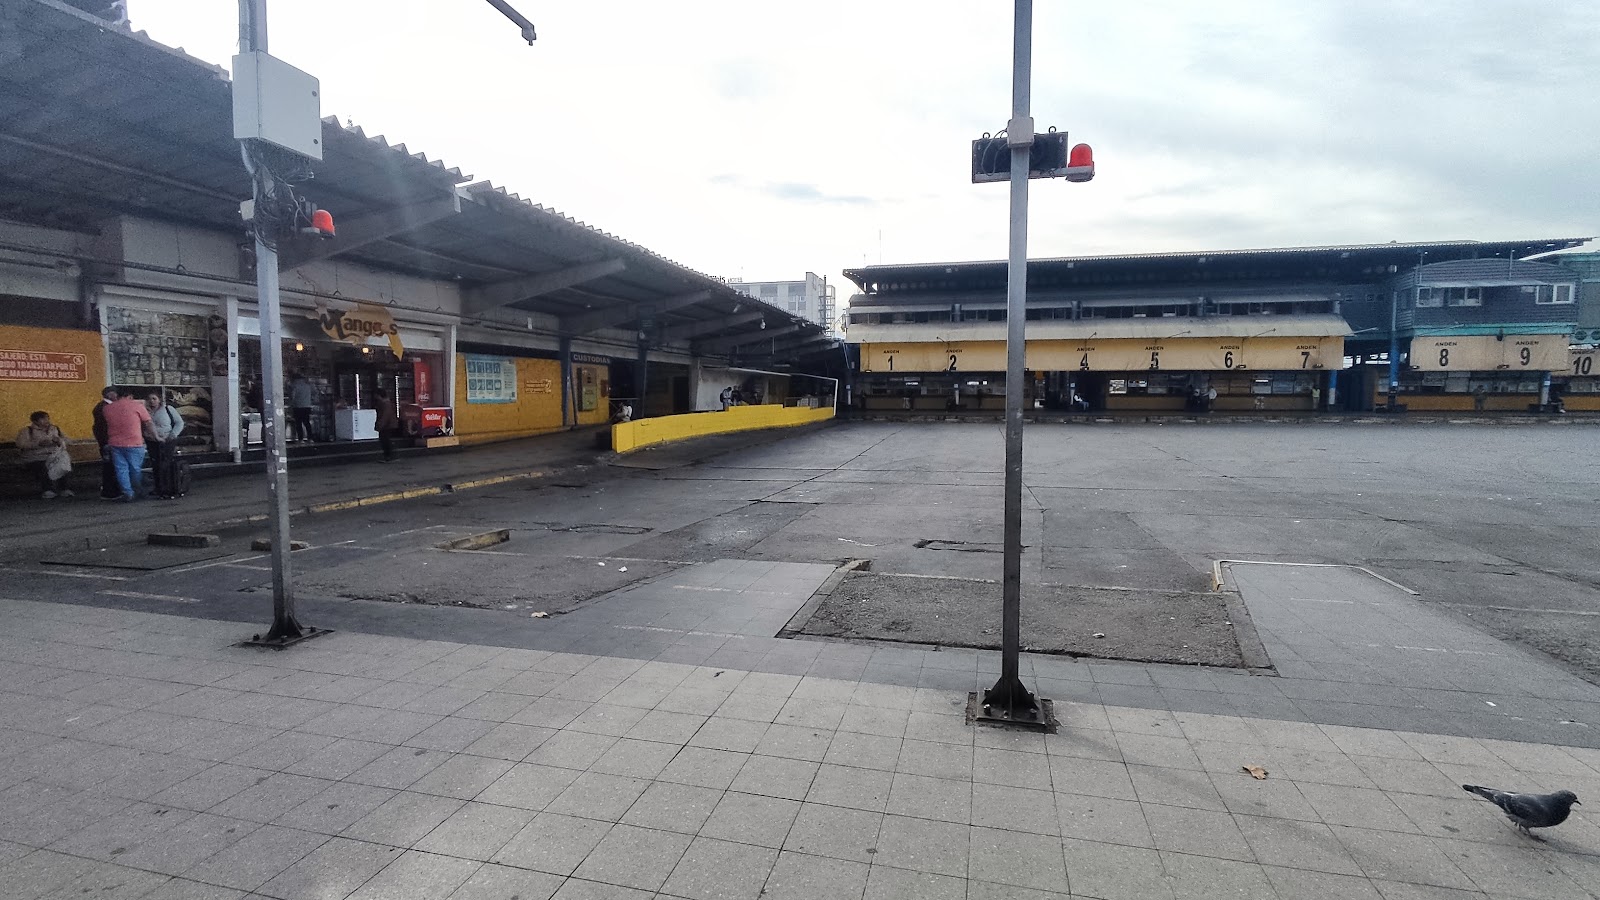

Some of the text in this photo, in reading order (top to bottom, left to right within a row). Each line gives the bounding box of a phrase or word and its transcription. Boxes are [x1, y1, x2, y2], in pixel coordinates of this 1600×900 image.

[573, 354, 611, 364] CUSTODIAS
[887, 355, 893, 371] 1
[949, 354, 957, 371] 2
[1150, 352, 1159, 369] 5
[1224, 351, 1233, 368] 6
[1301, 351, 1311, 369] 7
[1439, 348, 1449, 367] 8
[1520, 347, 1531, 366] 9
[10, 370, 47, 378] MANIOBRA
[17, 362, 54, 370] TRANSITAR
[1573, 356, 1592, 375] 10
